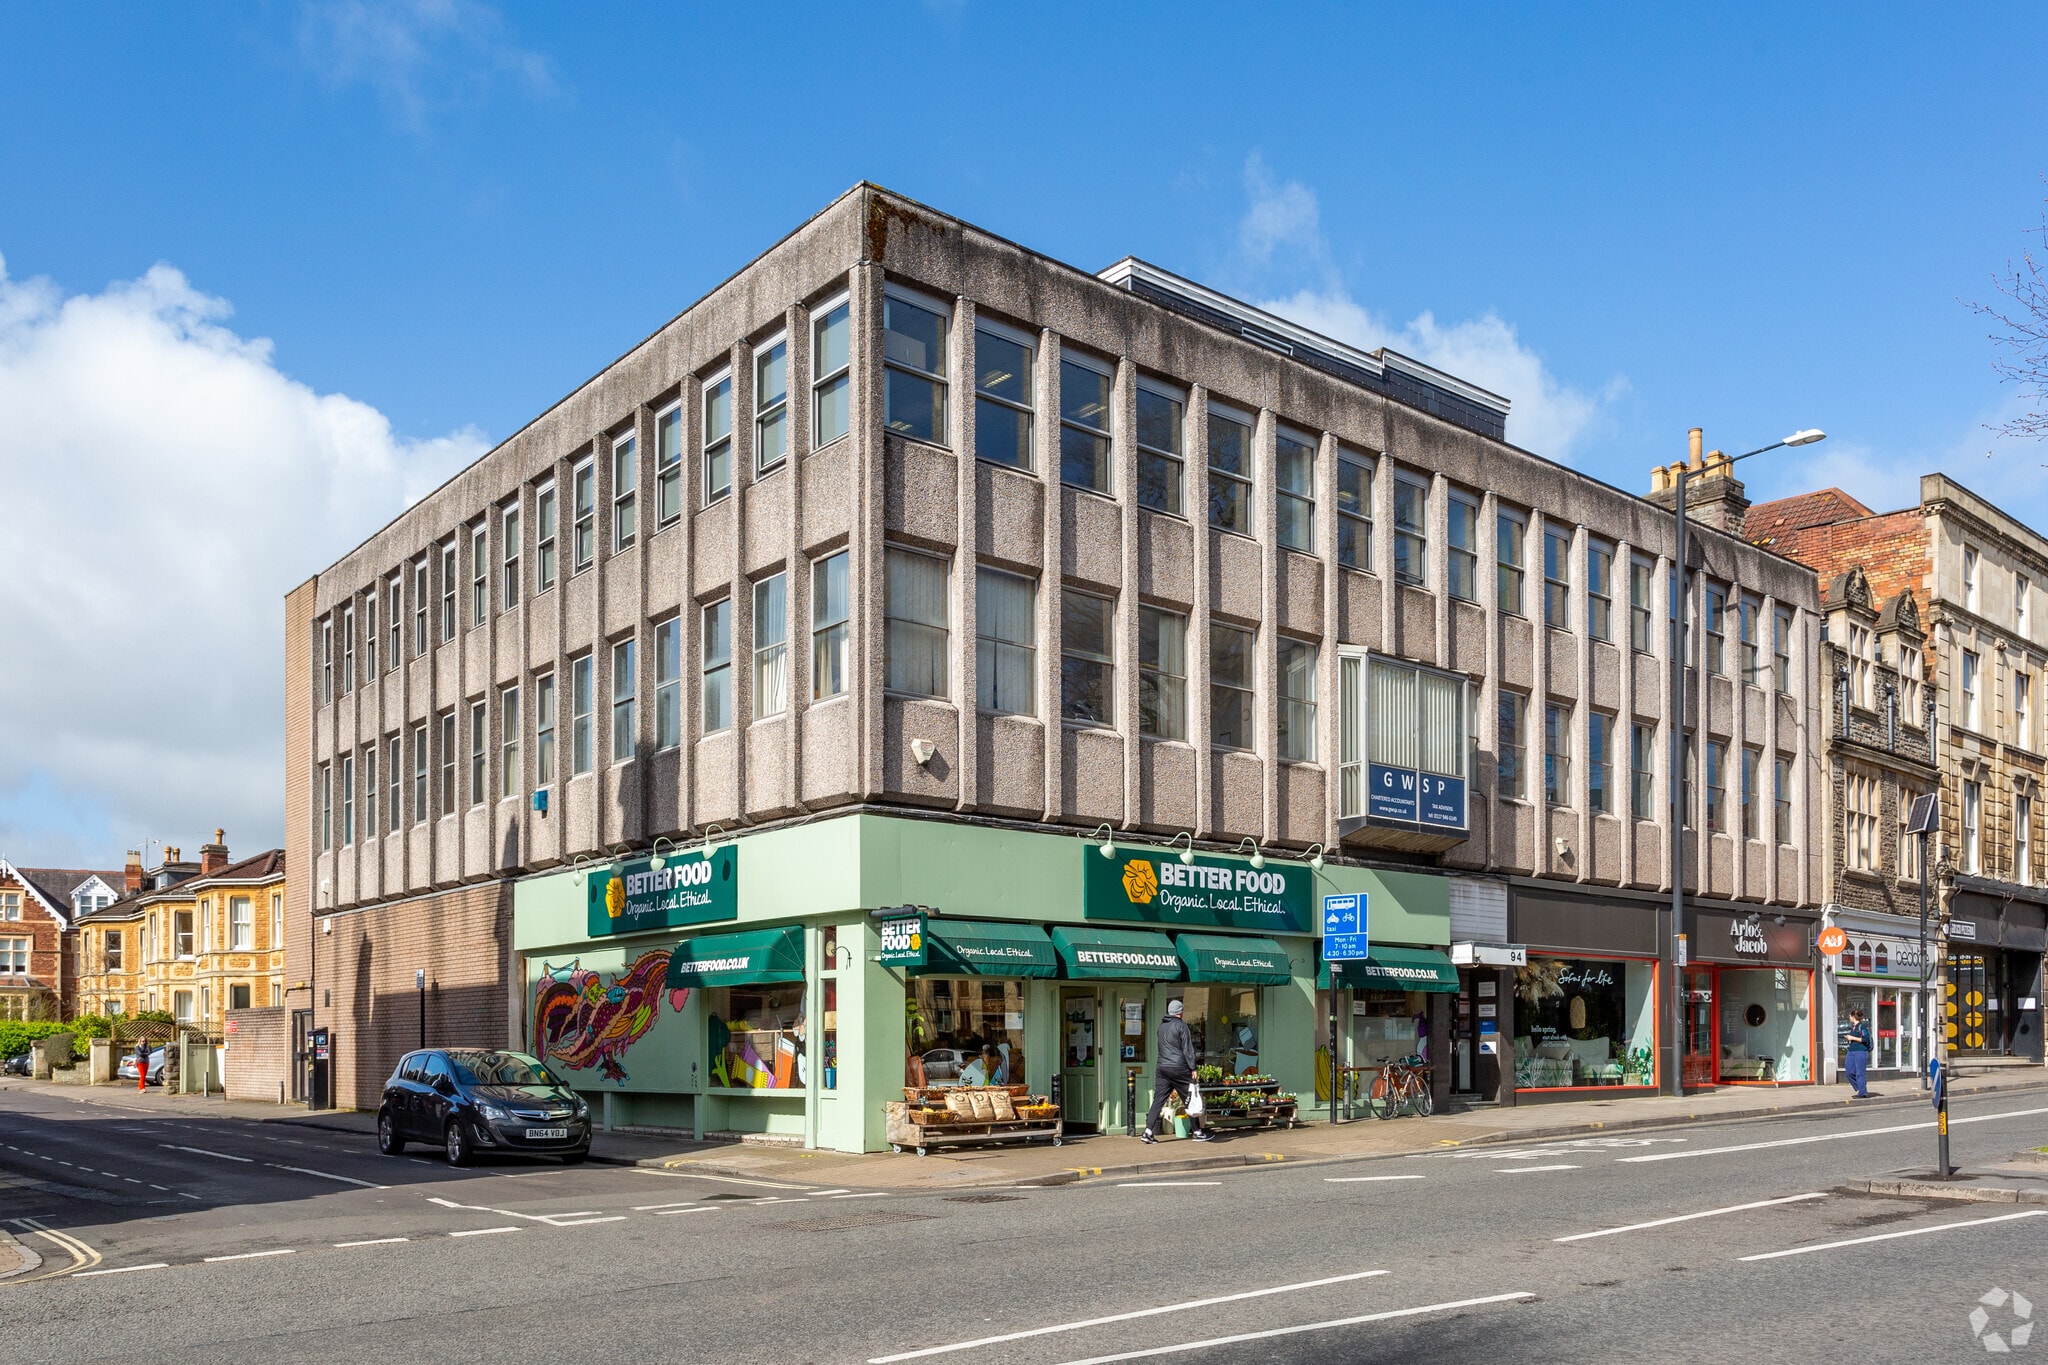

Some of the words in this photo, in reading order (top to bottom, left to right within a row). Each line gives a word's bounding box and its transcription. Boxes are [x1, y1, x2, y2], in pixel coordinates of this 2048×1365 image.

[627, 867, 673, 896] BETTER
[675, 860, 712, 888] FOOD
[1160, 862, 1232, 891] BETTER
[1235, 869, 1286, 895] FOOD
[626, 899, 656, 920] Organic.
[656, 895, 680, 911] Local.
[680, 889, 712, 907] Ethical.
[1160, 889, 1208, 913] Organic.
[1209, 893, 1243, 911] Local.
[1244, 896, 1286, 914] Ethical.
[881, 919, 920, 935] BETTER
[882, 934, 910, 951] FOOD
[1735, 936, 1767, 954] Jacob
[1822, 934, 1842, 948] A&J
[956, 945, 985, 958] Organic.
[985, 946, 1006, 956] Local.
[1006, 947, 1033, 957] Ethical.
[1077, 951, 1177, 967] BETTERFOOD.CO.UK
[1510, 951, 1522, 962] 94
[680, 956, 750, 973] BETTERFOOD.CO.UK
[1214, 957, 1236, 968] Organic.
[1252, 959, 1274, 968] Ethical.
[1365, 966, 1438, 980] BETTERFOOD.CO.UK
[1558, 967, 1581, 984] Sofas
[1581, 969, 1596, 987] for
[1595, 969, 1614, 986] life
[529, 1129, 548, 1138] BN64
